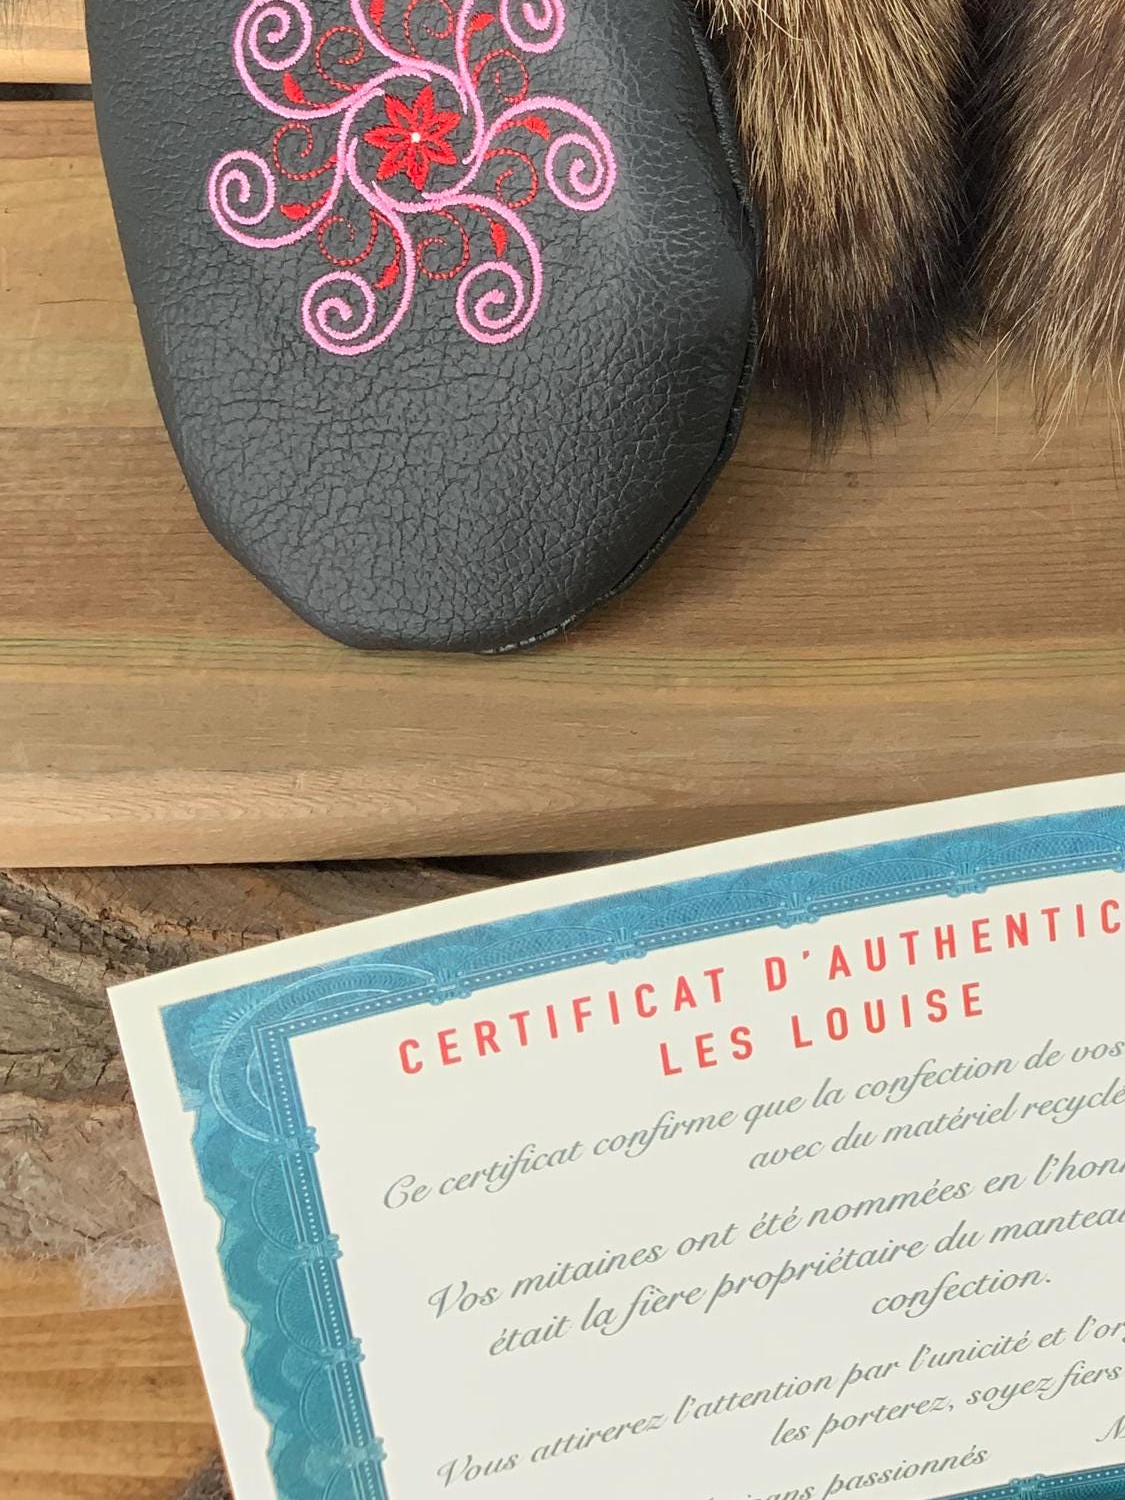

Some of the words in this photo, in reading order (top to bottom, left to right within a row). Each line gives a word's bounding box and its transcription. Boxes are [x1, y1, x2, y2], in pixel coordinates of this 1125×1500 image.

[399, 966, 727, 1075] CERTIFICAT
[659, 1026, 754, 1076] LES
[791, 982, 983, 1048] LOUISE
[439, 1140, 583, 1193] certificat
[593, 1110, 739, 1157] confirme
[744, 1094, 806, 1134] que
[812, 1077, 846, 1108] la
[855, 1058, 1016, 1104] confection
[1024, 1039, 1064, 1070] de
[749, 1134, 825, 1170] avec
[831, 1120, 878, 1153] du
[882, 1092, 1022, 1144] matériel
[427, 1280, 503, 1319] Vos
[510, 1242, 668, 1299] mitaines
[676, 1222, 739, 1257] ont
[749, 1205, 804, 1241] été
[806, 1178, 973, 1228] nommées
[983, 1173, 1027, 1195] en
[488, 1314, 572, 1356] était
[581, 1297, 617, 1332] la
[600, 1284, 708, 1336] fière
[704, 1239, 928, 1313] propriétaire
[934, 1220, 984, 1254] du
[871, 1269, 1052, 1318] confection.
[436, 1453, 520, 1488] Vous
[530, 1411, 667, 1464] attirerez
[673, 1374, 835, 1425] l'attention
[835, 1361, 902, 1398] par
[908, 1329, 1032, 1374] l'unicité
[1038, 1327, 1068, 1349] et
[770, 1417, 811, 1448] les
[811, 1393, 956, 1448] porterez,
[966, 1376, 1055, 1409] soyez
[822, 1444, 990, 1500] passionnés
